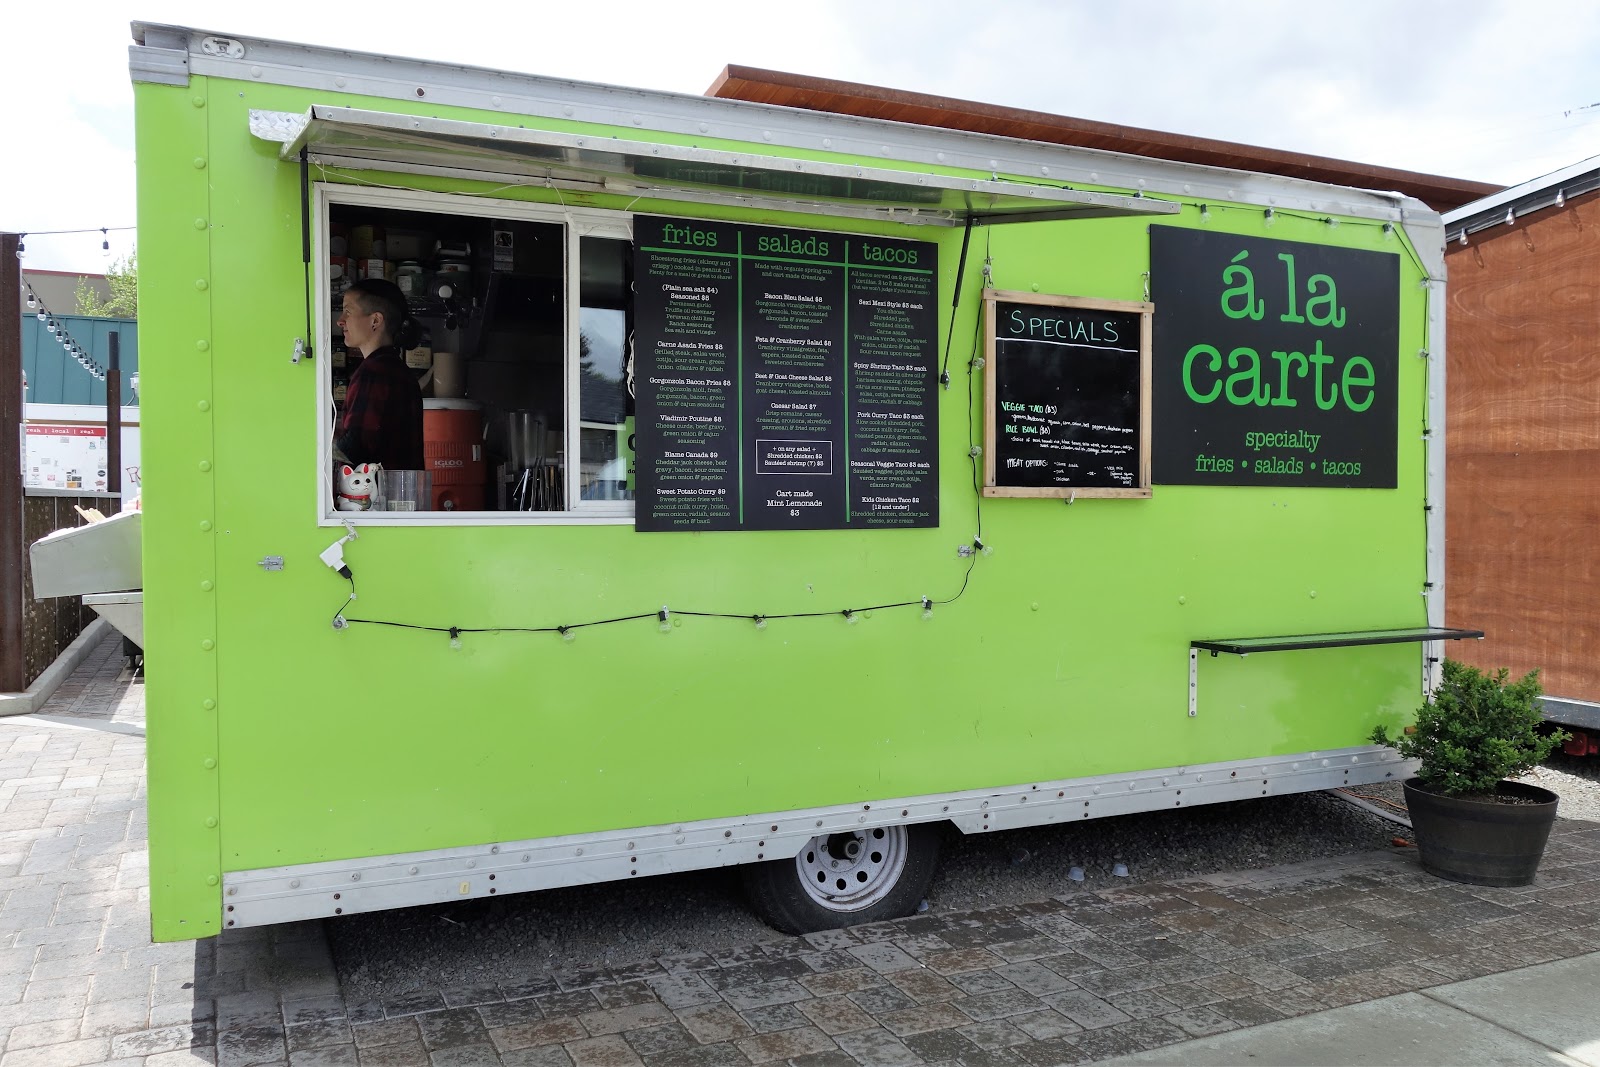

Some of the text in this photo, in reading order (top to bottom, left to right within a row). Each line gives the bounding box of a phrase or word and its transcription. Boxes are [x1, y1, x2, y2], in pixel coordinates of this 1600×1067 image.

[662, 224, 718, 247] fries
[758, 234, 829, 256] salads
[651, 255, 682, 264] Shoestring
[863, 242, 918, 264] tacos
[702, 266, 721, 274] peanut
[662, 284, 681, 292] (Plain
[1221, 250, 1346, 328] á la
[1010, 310, 1119, 342] SPECIALS
[870, 363, 891, 371] Shrimp
[1182, 340, 1376, 412] carte
[1002, 401, 1025, 411] VEGGIE
[1028, 405, 1043, 413] TACO
[1006, 424, 1018, 433] RICE
[1022, 425, 1038, 434] BOWL
[1246, 430, 1321, 452] specialty
[1007, 459, 1023, 468] MEAT
[1195, 455, 1361, 475] fries salads tacos
